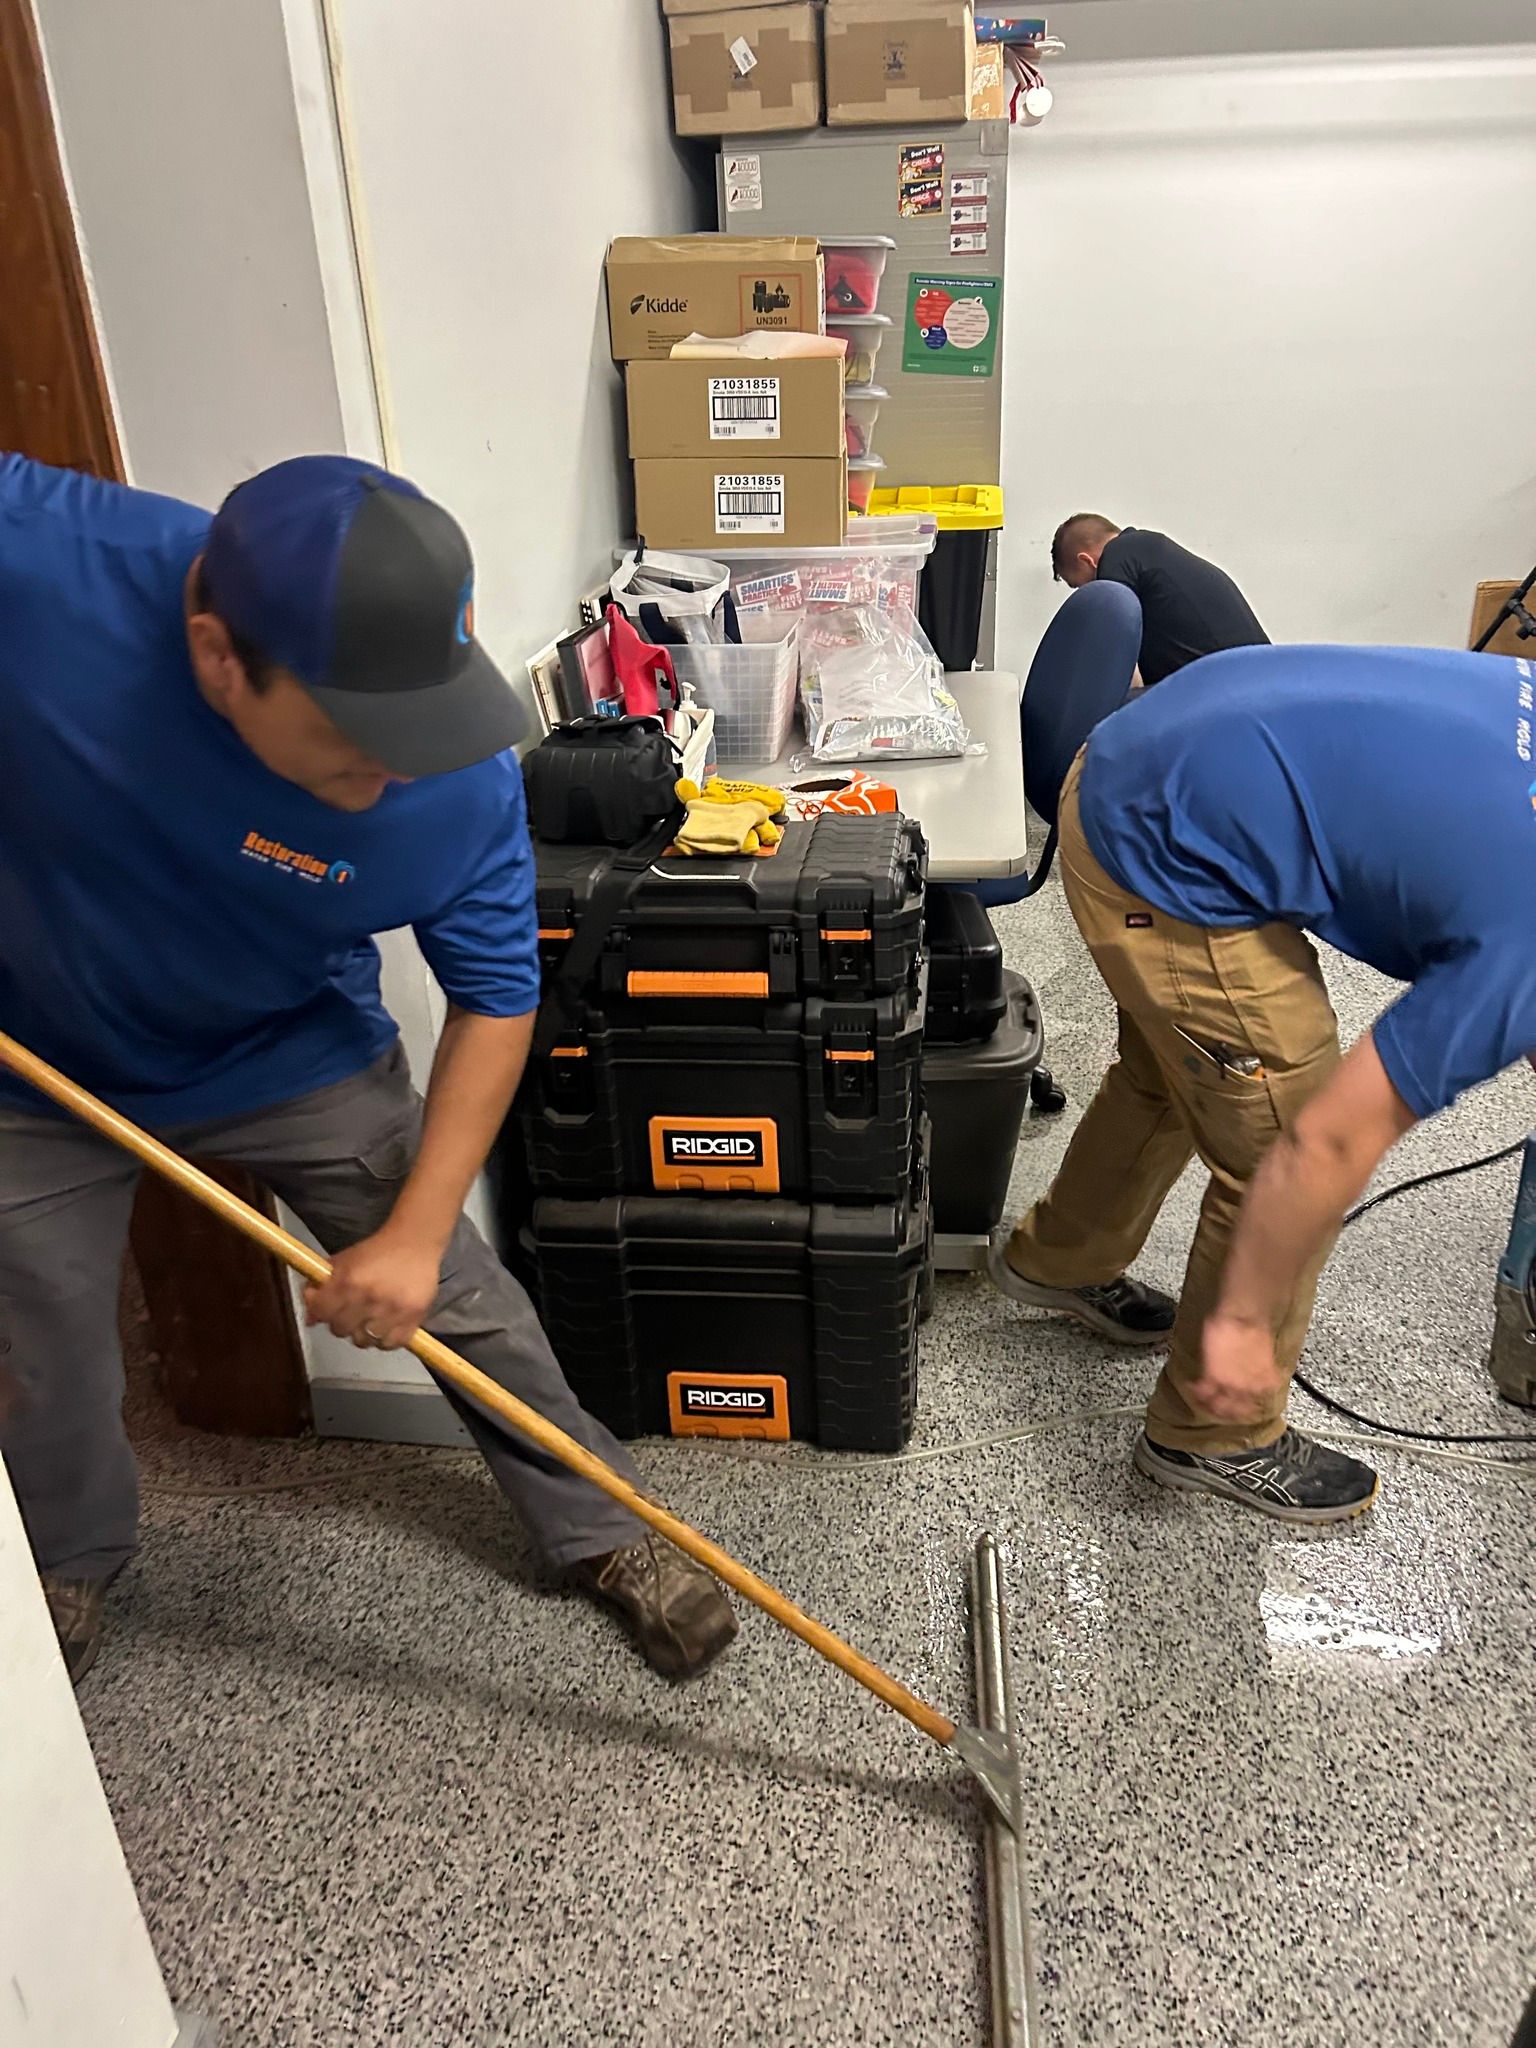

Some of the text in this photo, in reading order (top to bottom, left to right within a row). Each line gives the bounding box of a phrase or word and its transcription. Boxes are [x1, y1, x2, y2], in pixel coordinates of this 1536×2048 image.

[646, 297, 688, 313] Kidde
[756, 316, 788, 325] UN3091
[713, 379, 776, 390] 21031855
[719, 476, 781, 486] 21031855
[740, 573, 795, 596] SMARTIES
[742, 589, 778, 602] PRACTICE
[1517, 717, 1532, 761] MOLD
[243, 831, 329, 877] Restoration
[672, 1137, 755, 1154] RIDGID
[688, 1390, 766, 1408] RIDGID
